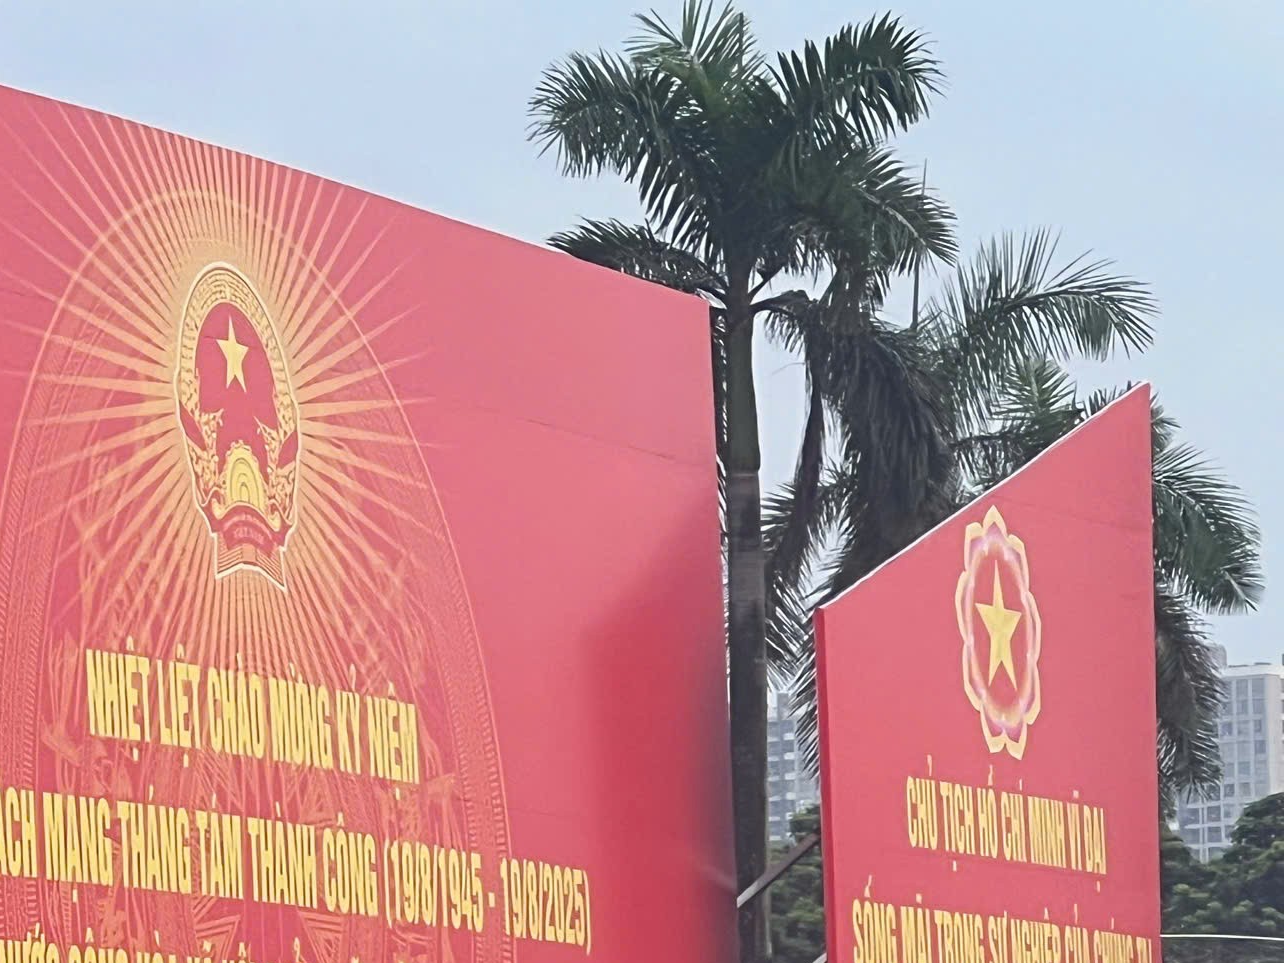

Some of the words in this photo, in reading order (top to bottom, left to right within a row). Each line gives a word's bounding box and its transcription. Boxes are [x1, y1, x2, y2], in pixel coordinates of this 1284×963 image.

[86, 636, 150, 761] NHIỆT
[157, 644, 201, 767] LIỆT
[207, 652, 266, 758] CHÀO
[367, 681, 419, 800] NIỆM
[43, 792, 113, 902] MẠNG
[117, 785, 191, 894] THÁNG
[196, 794, 243, 899] TÁM
[247, 802, 318, 908] THÀNH
[322, 813, 378, 917] CÔNG
[384, 838, 484, 932] (19/8/1945
[500, 857, 591, 955] 19/8/2025)
[906, 754, 938, 850] CHỦ
[940, 781, 975, 871] TỊCH
[1001, 778, 1027, 862] CHÍ
[1028, 796, 1066, 868] MINH
